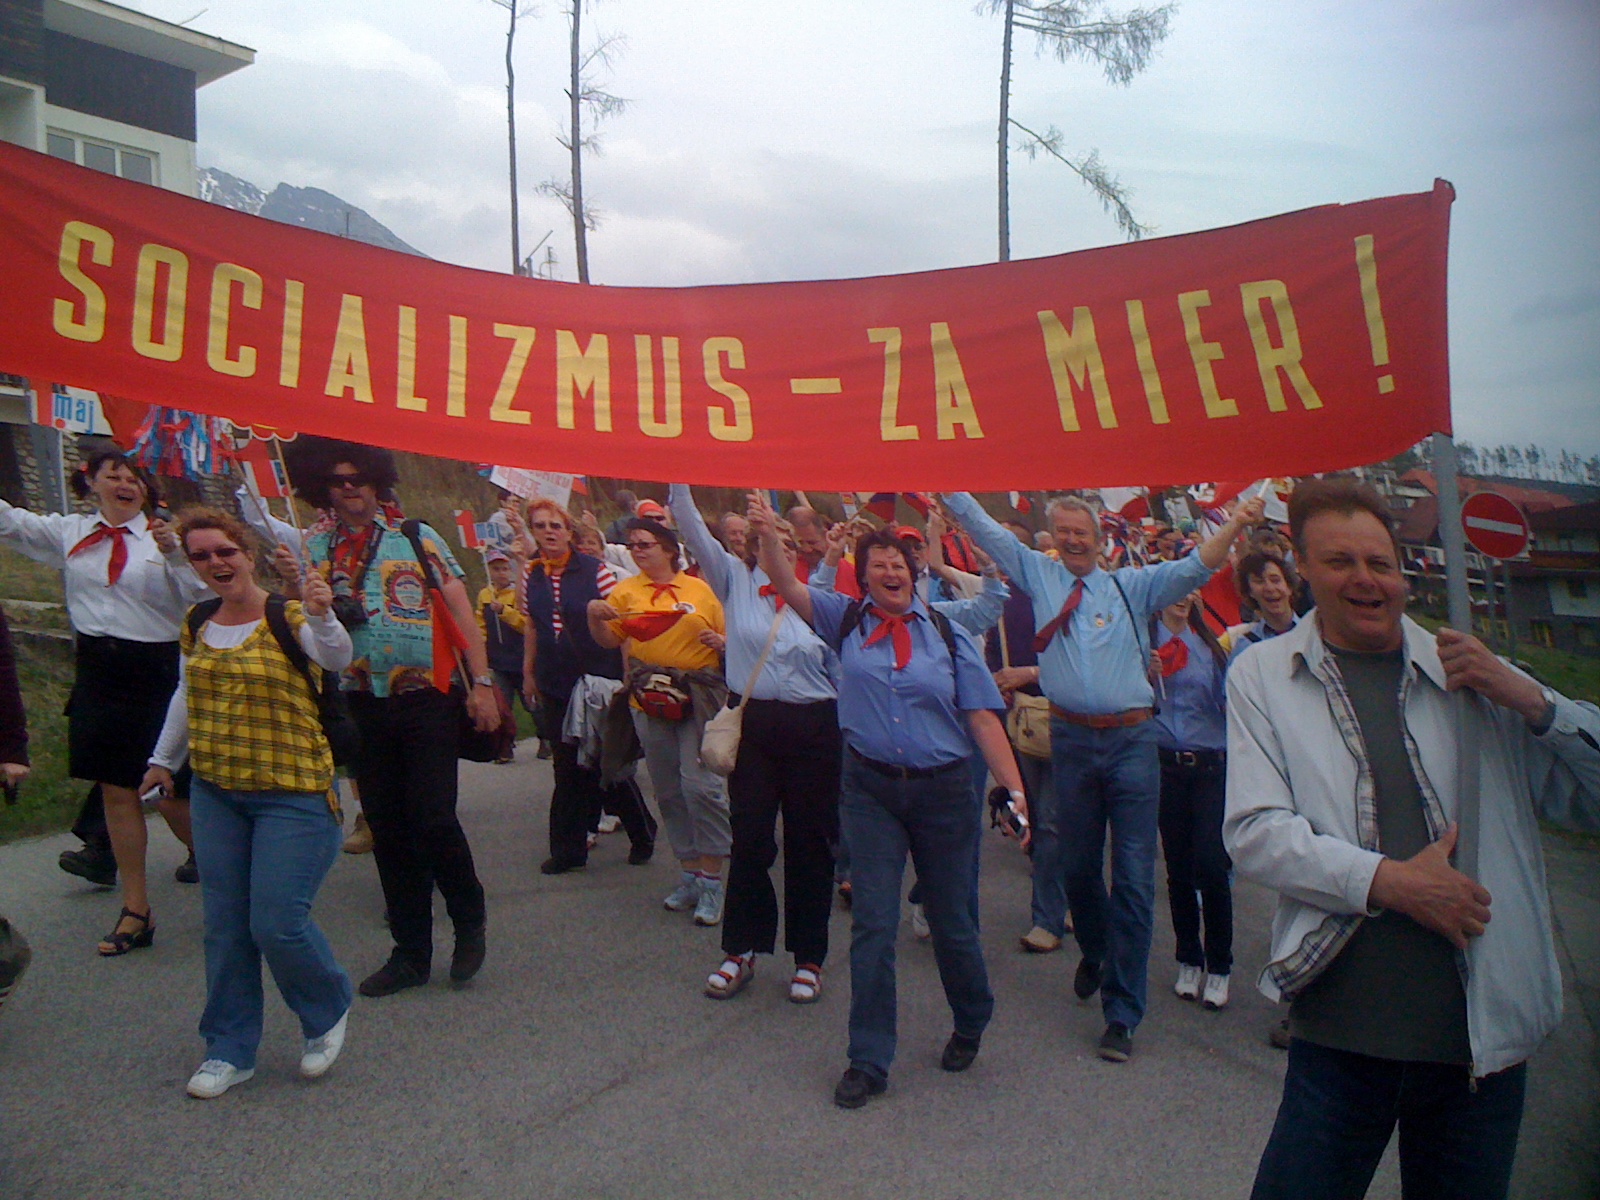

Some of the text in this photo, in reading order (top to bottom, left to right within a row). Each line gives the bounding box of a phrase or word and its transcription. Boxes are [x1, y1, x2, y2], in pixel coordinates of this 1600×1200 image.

[53, 220, 753, 442] SOCIALIZMUS
[867, 321, 985, 442] ZA
[1037, 279, 1324, 432] MIER
[54, 394, 95, 435] maj
